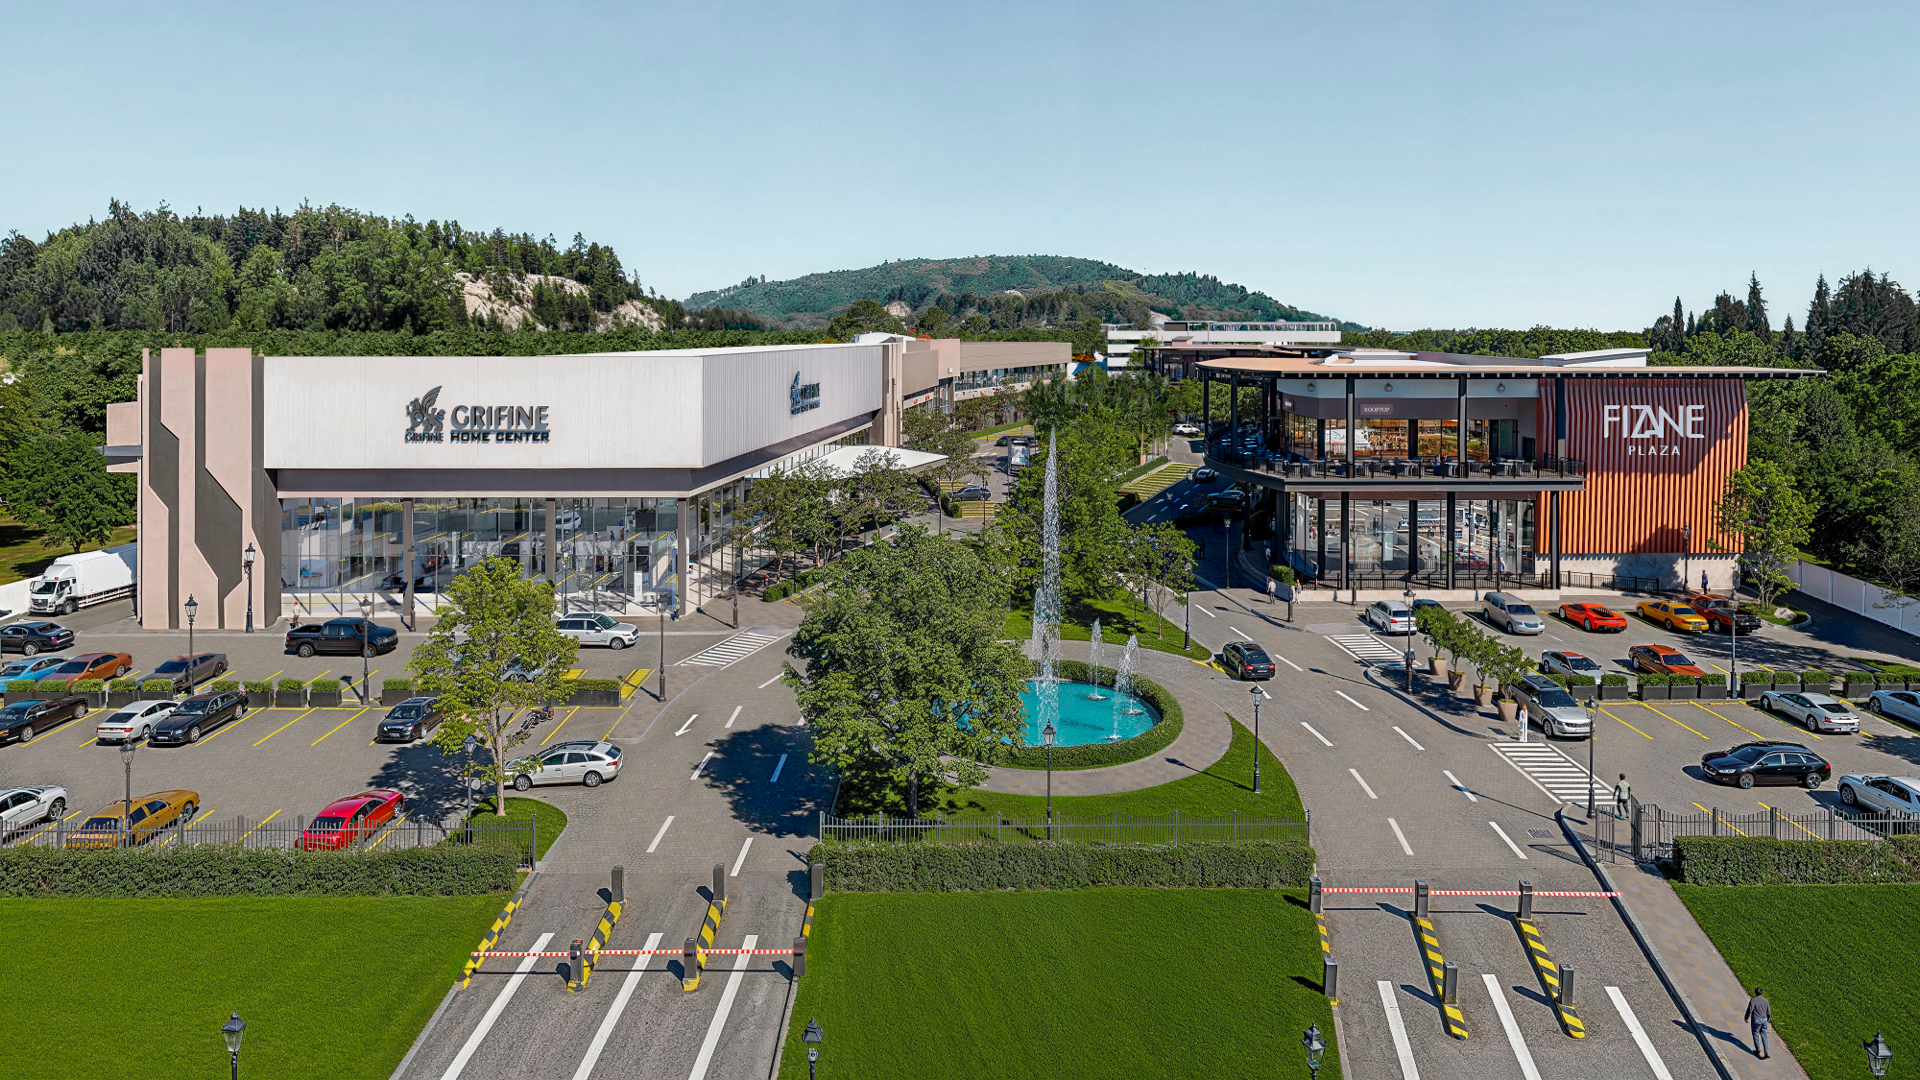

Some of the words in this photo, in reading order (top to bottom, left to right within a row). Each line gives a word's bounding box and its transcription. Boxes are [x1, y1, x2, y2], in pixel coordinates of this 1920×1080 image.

[450, 405, 549, 428] GRIFINE
[404, 432, 444, 442] GRIFINE
[450, 432, 491, 442] HOME
[495, 432, 550, 442] CENTER
[1628, 445, 1681, 456] PLAZA
